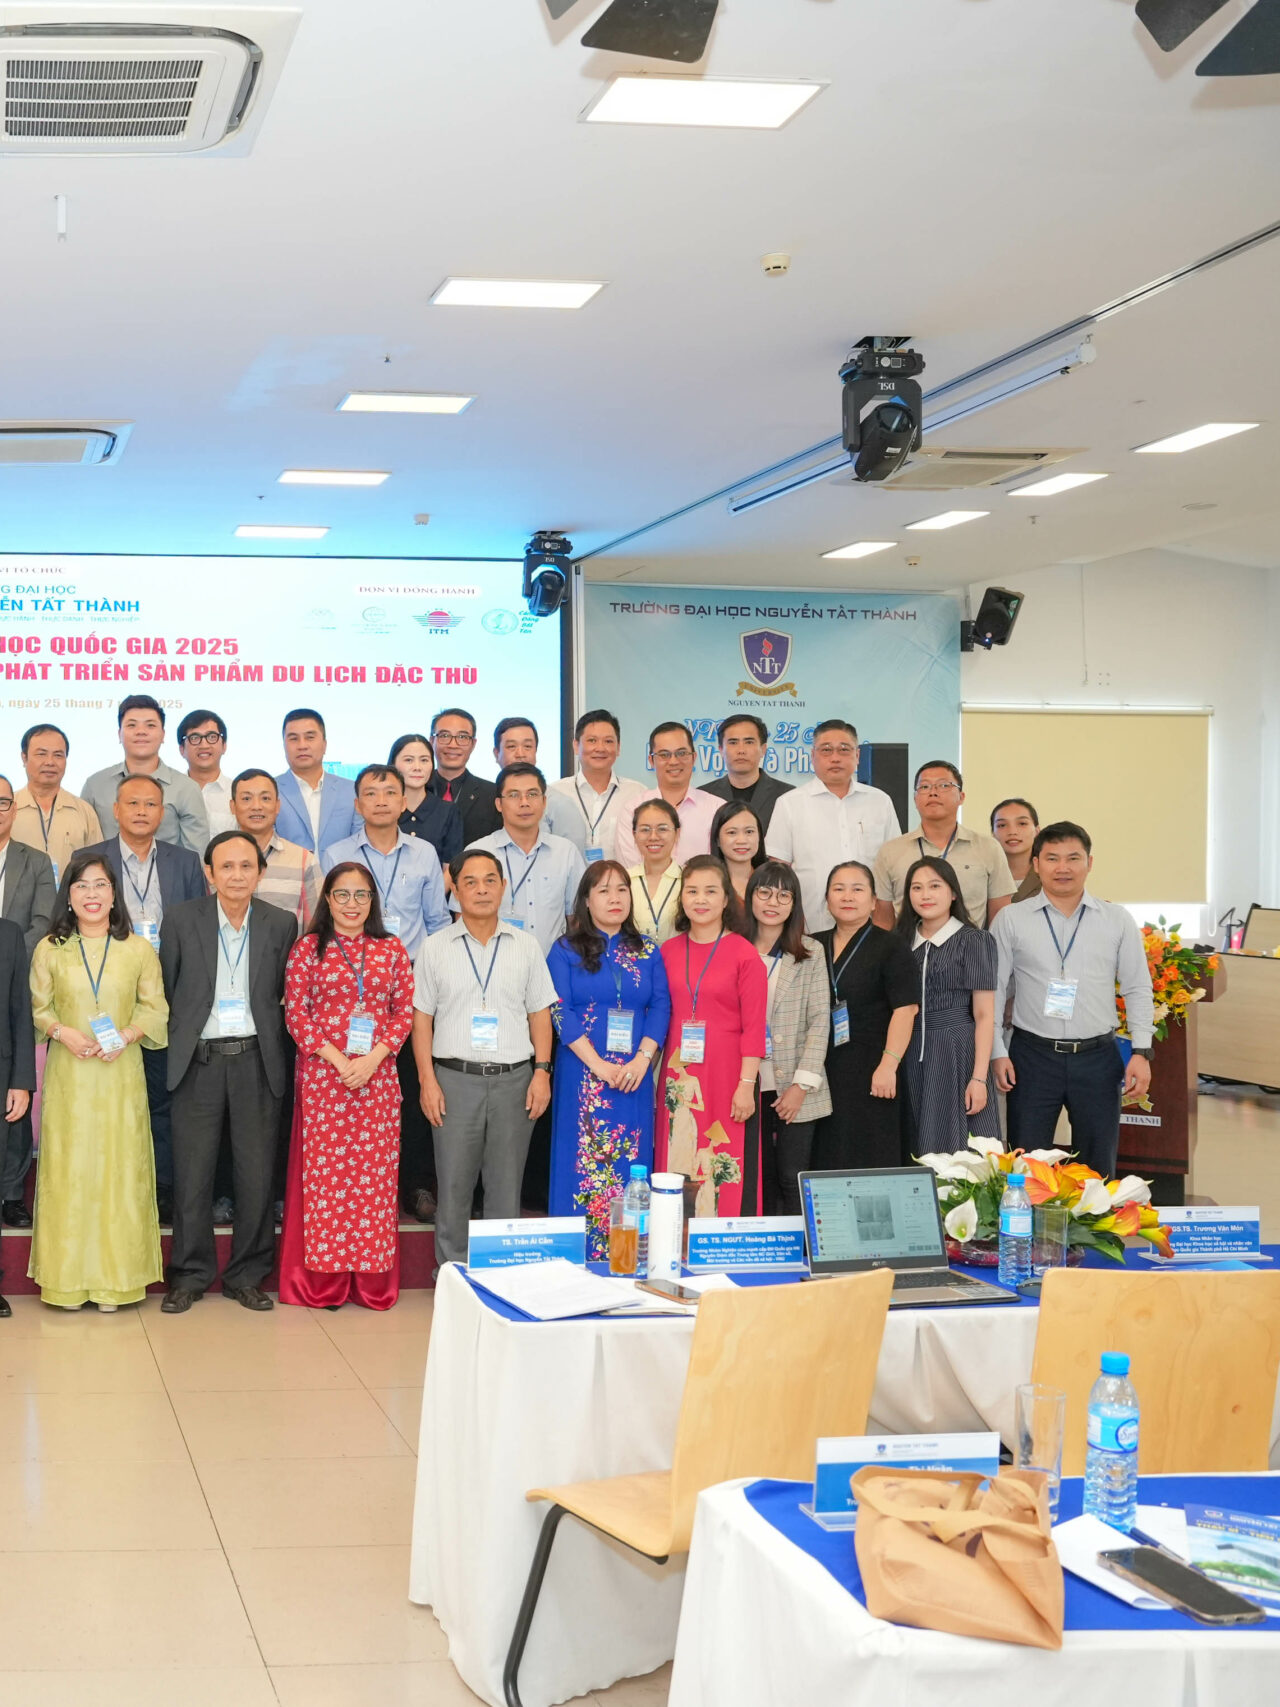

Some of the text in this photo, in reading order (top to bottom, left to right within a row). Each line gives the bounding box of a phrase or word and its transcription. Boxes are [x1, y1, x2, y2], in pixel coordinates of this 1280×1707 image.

[878, 382, 895, 391] DSL
[31, 596, 65, 611] TẤT
[74, 597, 140, 612] THÀNH
[609, 601, 917, 621] TRƯỜNG ĐẠI HỌC NGUYỄN TẤT THÀNH
[50, 630, 117, 655] QUỐC
[126, 637, 167, 656] GIA
[175, 637, 239, 656] 2025
[60, 657, 130, 682] TRIỂN
[138, 660, 186, 682] SẢN
[194, 657, 263, 683] PHẨM
[272, 665, 304, 683] DU
[313, 665, 366, 686] LỊCH
[375, 663, 423, 687] ĐẶC
[431, 664, 478, 685] THÙ
[753, 657, 781, 675] NTT
[157, 699, 183, 709] 025
[773, 722, 800, 744] 25
[1126, 1116, 1160, 1125] THANH
